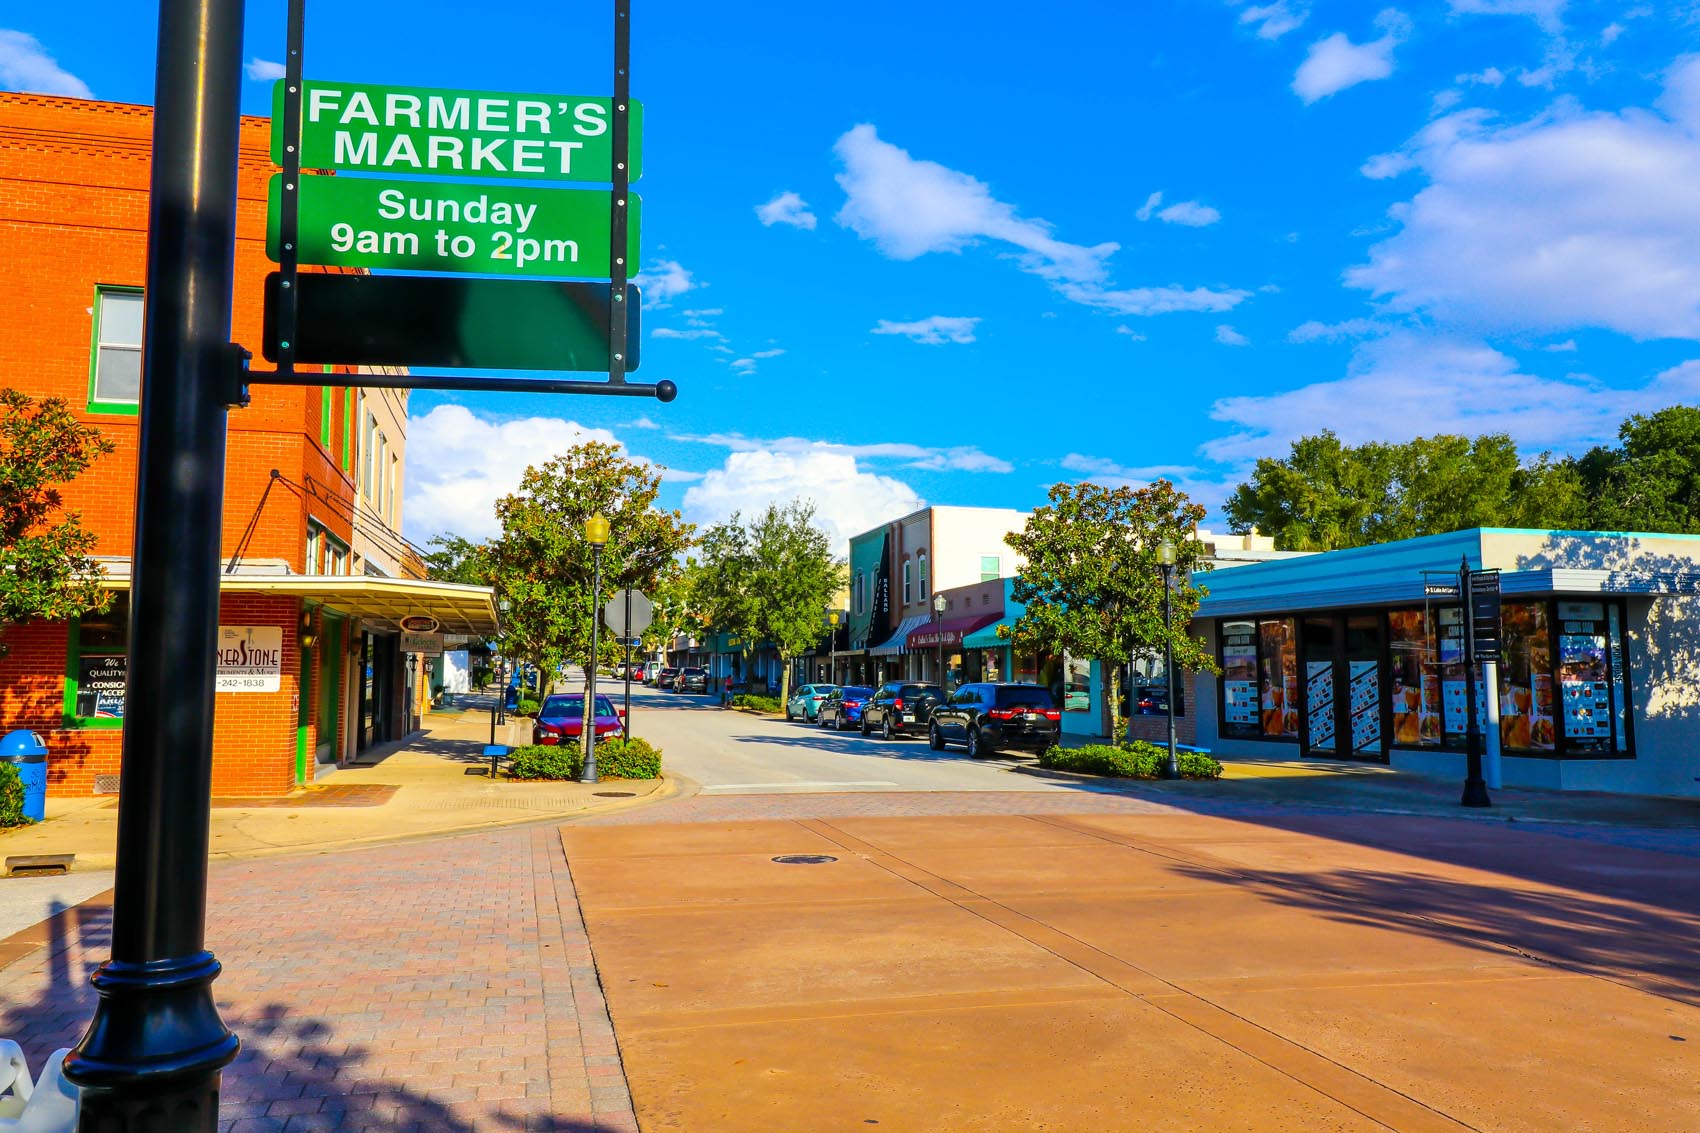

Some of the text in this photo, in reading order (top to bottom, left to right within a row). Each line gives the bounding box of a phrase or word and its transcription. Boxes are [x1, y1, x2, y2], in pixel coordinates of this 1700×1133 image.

[309, 88, 607, 136] FARMER'S
[333, 130, 583, 174] MARKET
[378, 189, 537, 232] Sunday
[330, 223, 579, 267] 9am to 2pm
[1613, 645, 1622, 682] MONTROSE
